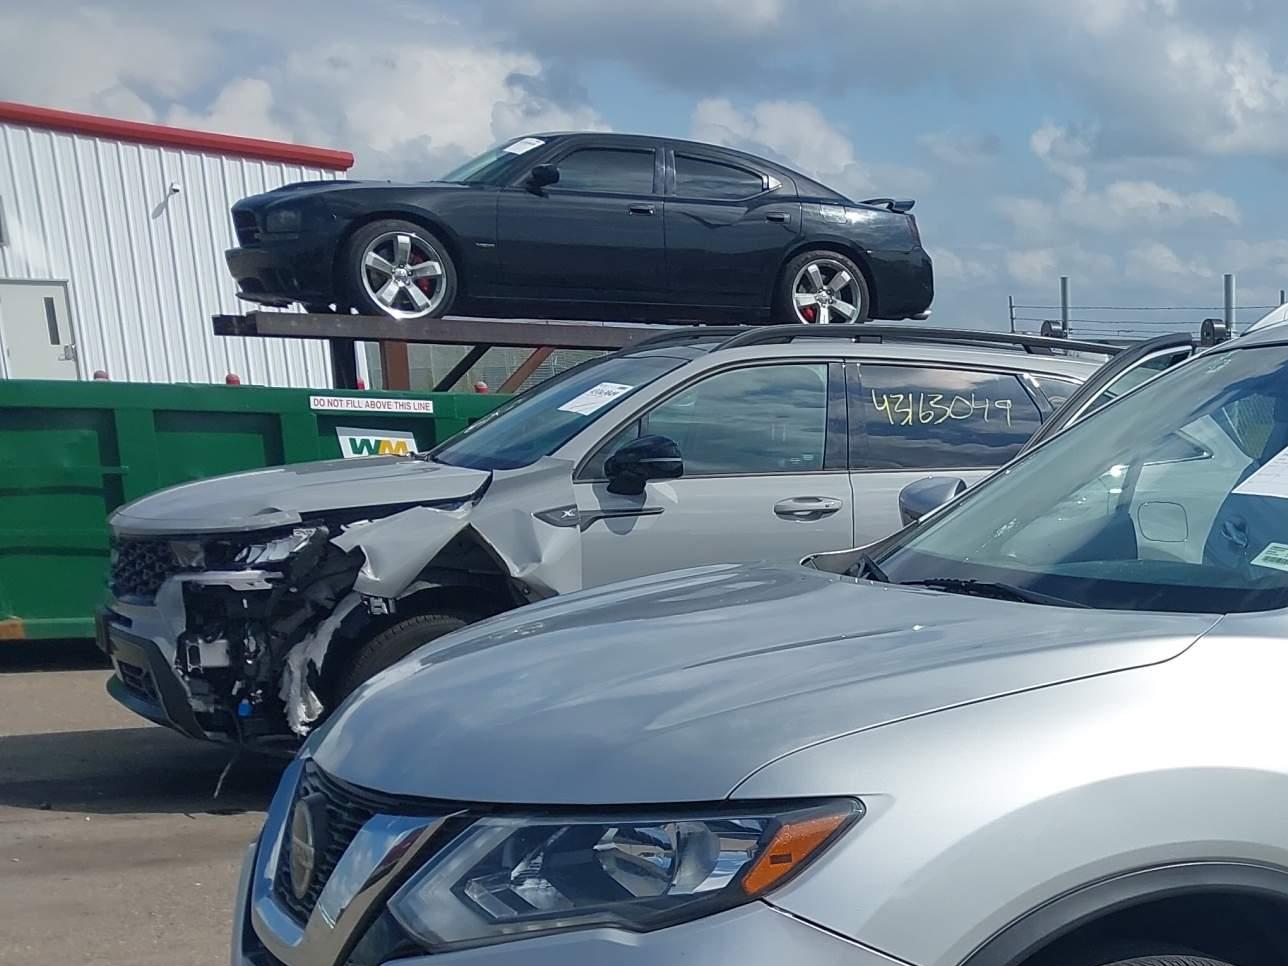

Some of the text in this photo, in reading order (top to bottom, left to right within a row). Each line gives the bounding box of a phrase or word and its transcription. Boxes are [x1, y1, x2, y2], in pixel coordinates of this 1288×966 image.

[313, 398, 431, 411] DO NOT FILL ABOVE THIS LINE
[871, 389, 1012, 427] 43163049
[348, 437, 409, 455] WM
